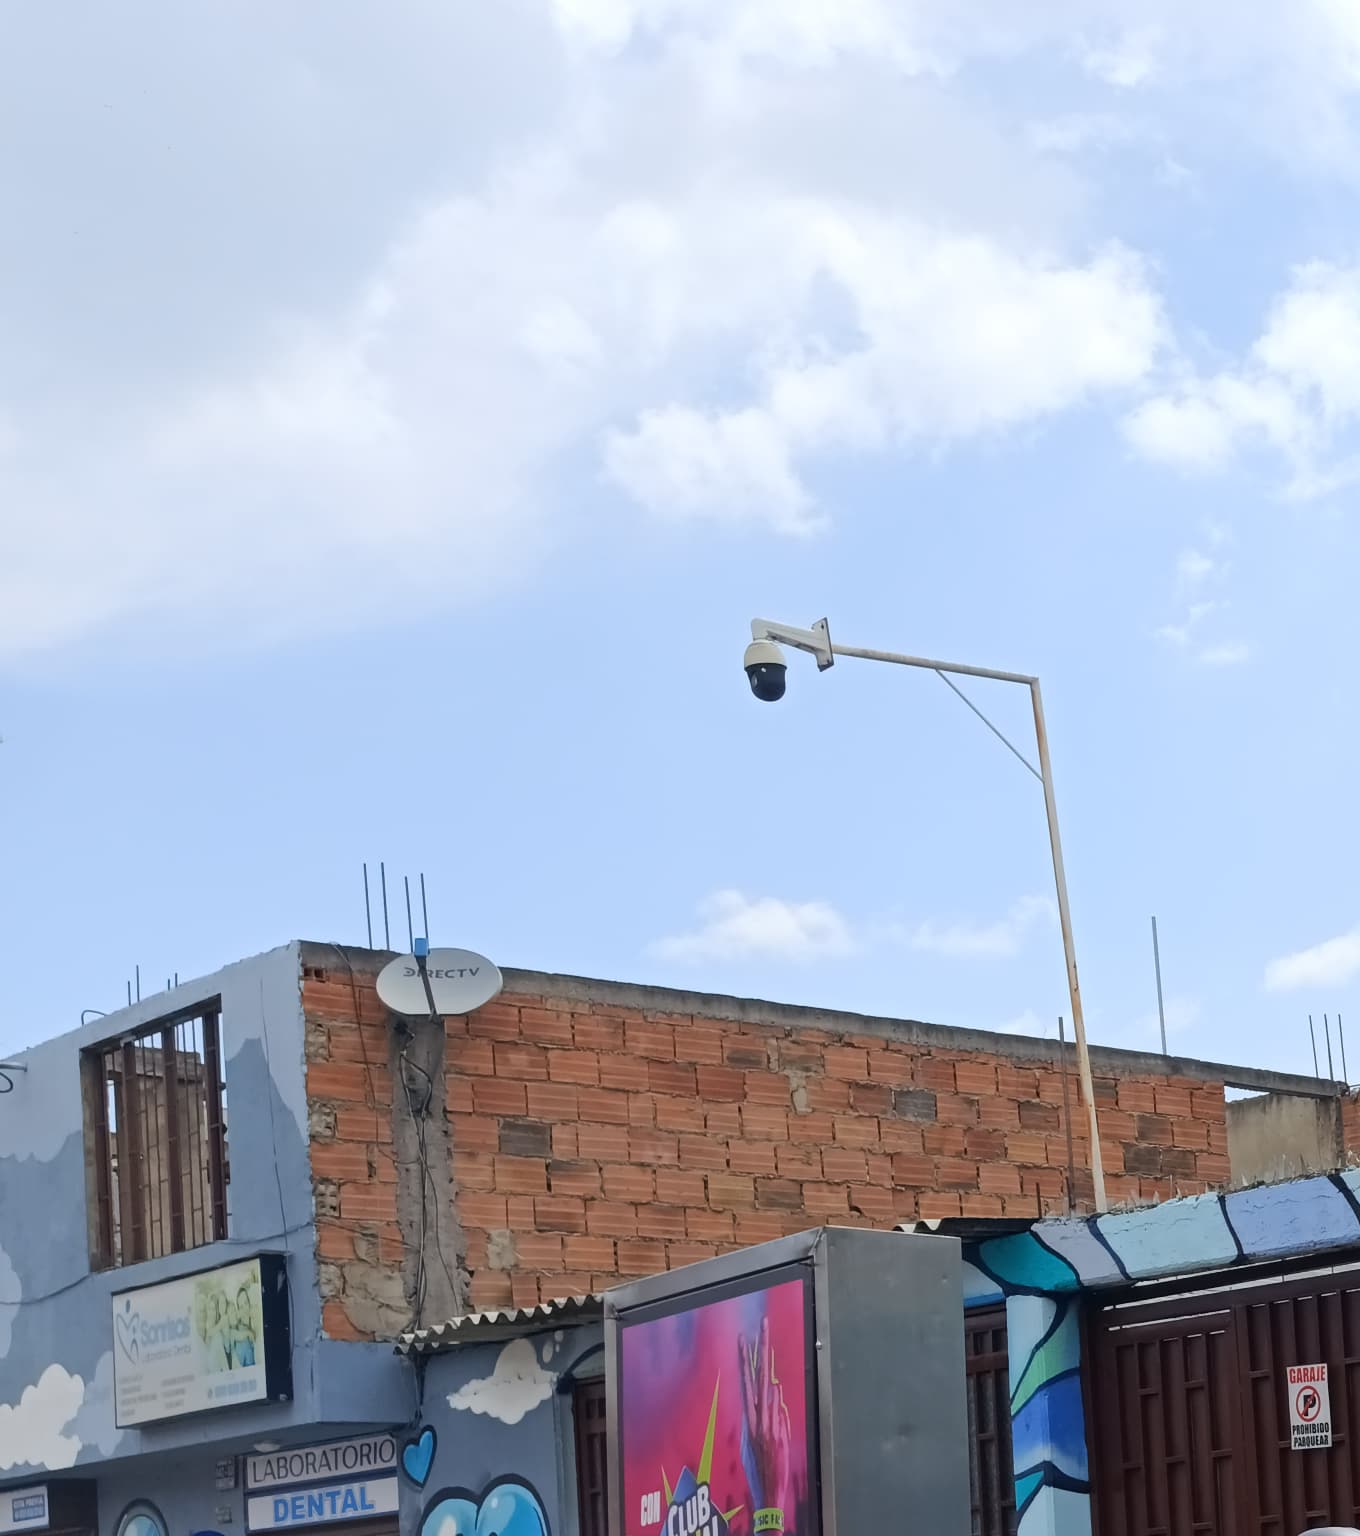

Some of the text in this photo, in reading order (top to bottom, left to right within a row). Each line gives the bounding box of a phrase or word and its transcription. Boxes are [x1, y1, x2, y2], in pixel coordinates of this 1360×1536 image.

[403, 967, 480, 979] DIRECTV
[1289, 1366, 1326, 1384] GARAJE
[1292, 1422, 1330, 1435] PROHIBIDO
[1294, 1435, 1329, 1448] PARQUEAR
[252, 1438, 395, 1483] LABORATORIO
[273, 1486, 375, 1523] DENTAL
[640, 1491, 661, 1527] CON
